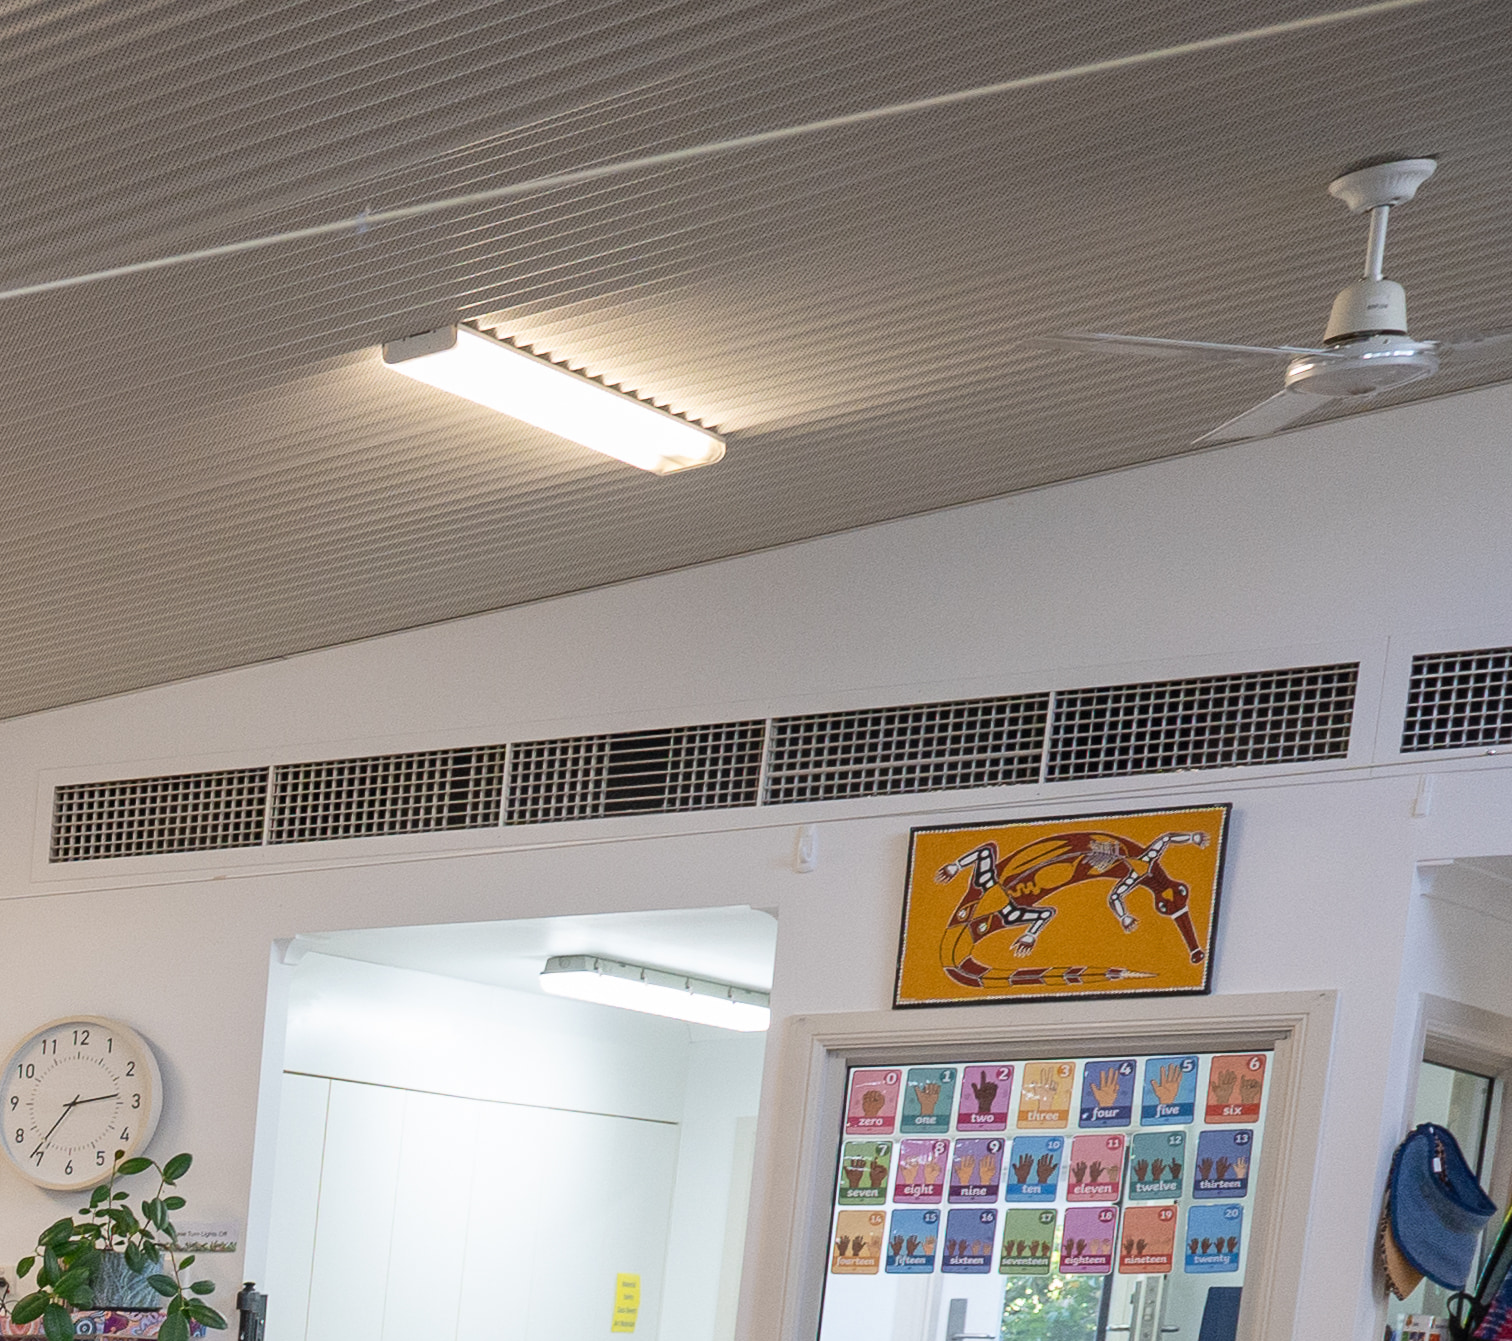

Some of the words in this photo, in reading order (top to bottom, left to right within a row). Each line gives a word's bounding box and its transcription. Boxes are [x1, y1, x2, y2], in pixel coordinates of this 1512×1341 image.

[72, 1029, 90, 1046] 12
[41, 1039, 57, 1055] 11
[107, 1037, 113, 1054] 1
[125, 1061, 135, 1077] 2
[1119, 1063, 1131, 1075] 4
[1182, 1060, 1193, 1072] 5
[1249, 1058, 1260, 1070] 6
[17, 1063, 35, 1079] 10
[998, 1067, 1009, 1080] 2
[1059, 1065, 1070, 1077] 3
[886, 1072, 898, 1084] 0
[942, 1071, 951, 1083] 1
[10, 1095, 20, 1112] 9
[131, 1093, 141, 1109] 3
[1091, 1108, 1119, 1121] four
[1155, 1105, 1180, 1118] five
[1223, 1105, 1242, 1116] six
[915, 1116, 937, 1124] one
[970, 1114, 994, 1123] two
[1028, 1111, 1059, 1121] three
[858, 1117, 883, 1126] zero
[15, 1128, 24, 1143] 8
[119, 1127, 129, 1142] 4
[1235, 1133, 1248, 1143] 13
[1048, 1140, 1060, 1149] 10
[1108, 1139, 1120, 1148] 11
[1168, 1135, 1181, 1145] 12
[878, 1144, 888, 1156] 7
[934, 1142, 945, 1156] 8
[990, 1141, 999, 1153] 9
[36, 1151, 45, 1167] 7
[96, 1151, 106, 1166] 5
[64, 1159, 73, 1175] 6
[1021, 1185, 1041, 1194] ten
[1073, 1184, 1112, 1194] eleven
[1135, 1182, 1177, 1192] twelve
[1200, 1180, 1241, 1189] thirteen
[846, 1189, 878, 1198] seven
[904, 1184, 934, 1197] eight
[960, 1186, 987, 1196] nine
[870, 1213, 882, 1223] 14
[924, 1212, 937, 1221] 15
[981, 1212, 993, 1222] 16
[1041, 1213, 1053, 1222] 17
[1099, 1211, 1113, 1220] 18
[1160, 1209, 1173, 1219] 19
[1225, 1209, 1239, 1218] 20
[836, 1256, 875, 1266] fourteen
[894, 1256, 926, 1266] fifteen
[949, 1256, 984, 1265] sixteen
[1001, 1257, 1049, 1266] seventeen
[1065, 1255, 1106, 1265] eighteen
[1124, 1255, 1167, 1264] nineteen
[1194, 1254, 1231, 1265] twenty
